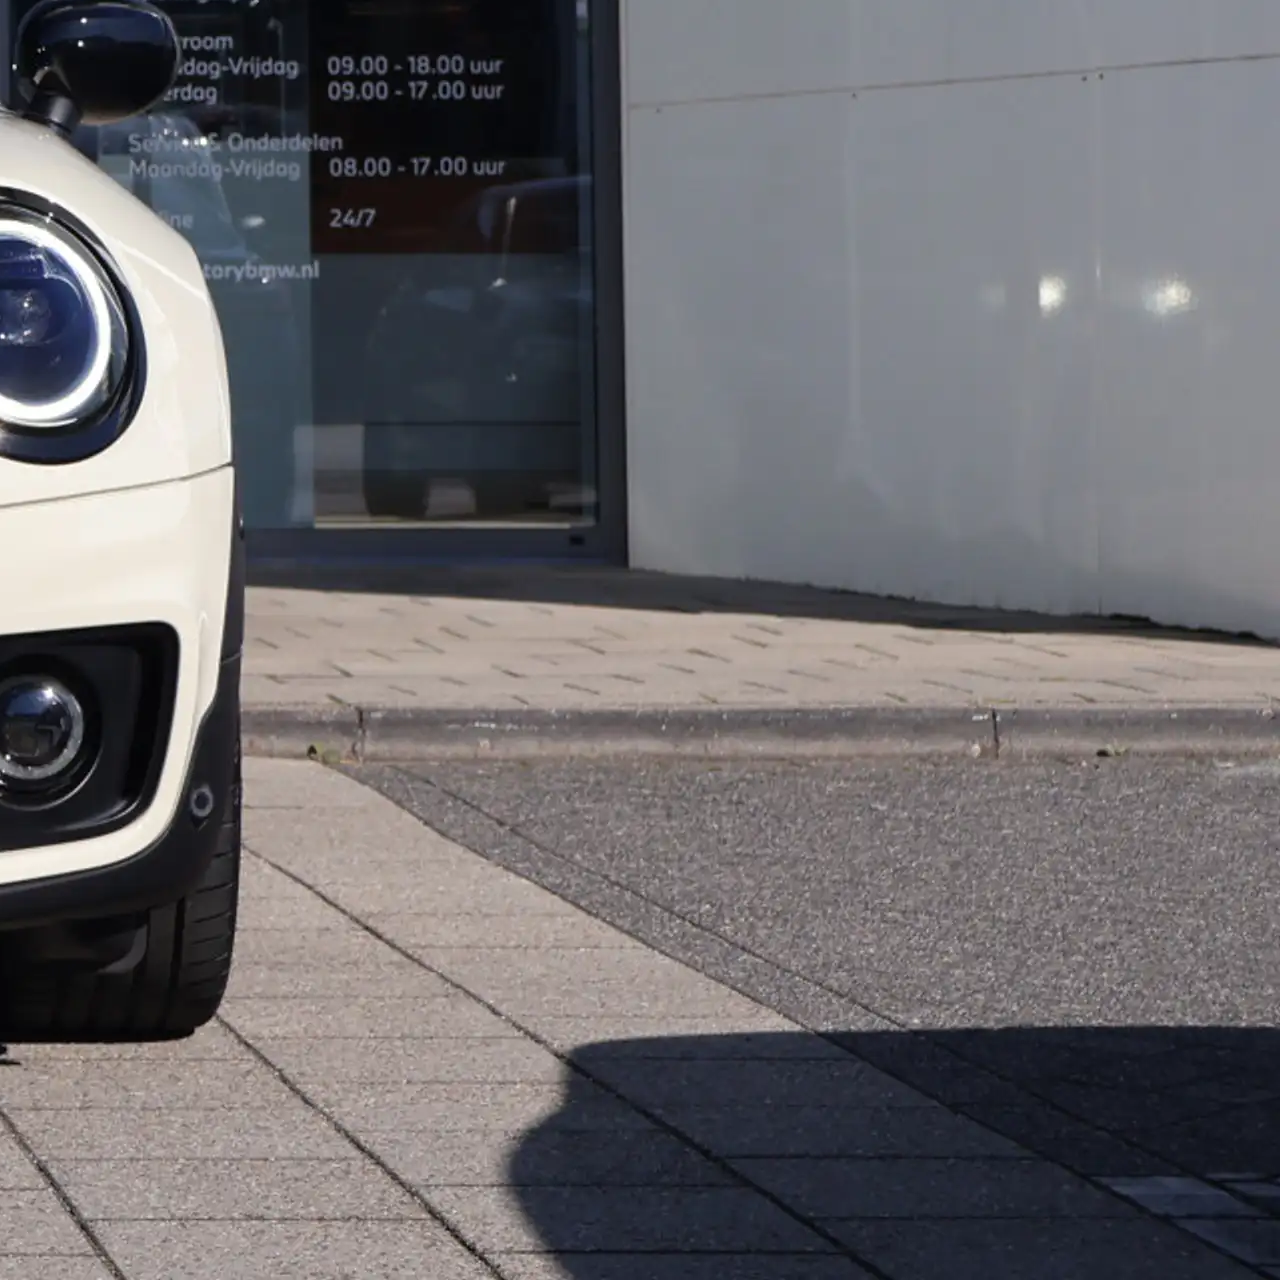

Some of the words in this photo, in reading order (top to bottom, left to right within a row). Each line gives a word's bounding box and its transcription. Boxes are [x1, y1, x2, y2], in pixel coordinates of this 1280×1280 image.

[327, 56, 389, 75] 09.00
[407, 55, 465, 75] 18.00
[470, 60, 503, 74] uur
[327, 81, 389, 101] 09.00
[471, 85, 504, 99] uur
[228, 132, 344, 152] Onderdelen
[129, 158, 301, 181] Maandag-Vrijdag
[330, 157, 392, 177] 08.00
[473, 161, 506, 175] uur
[329, 208, 377, 228] 24/7
